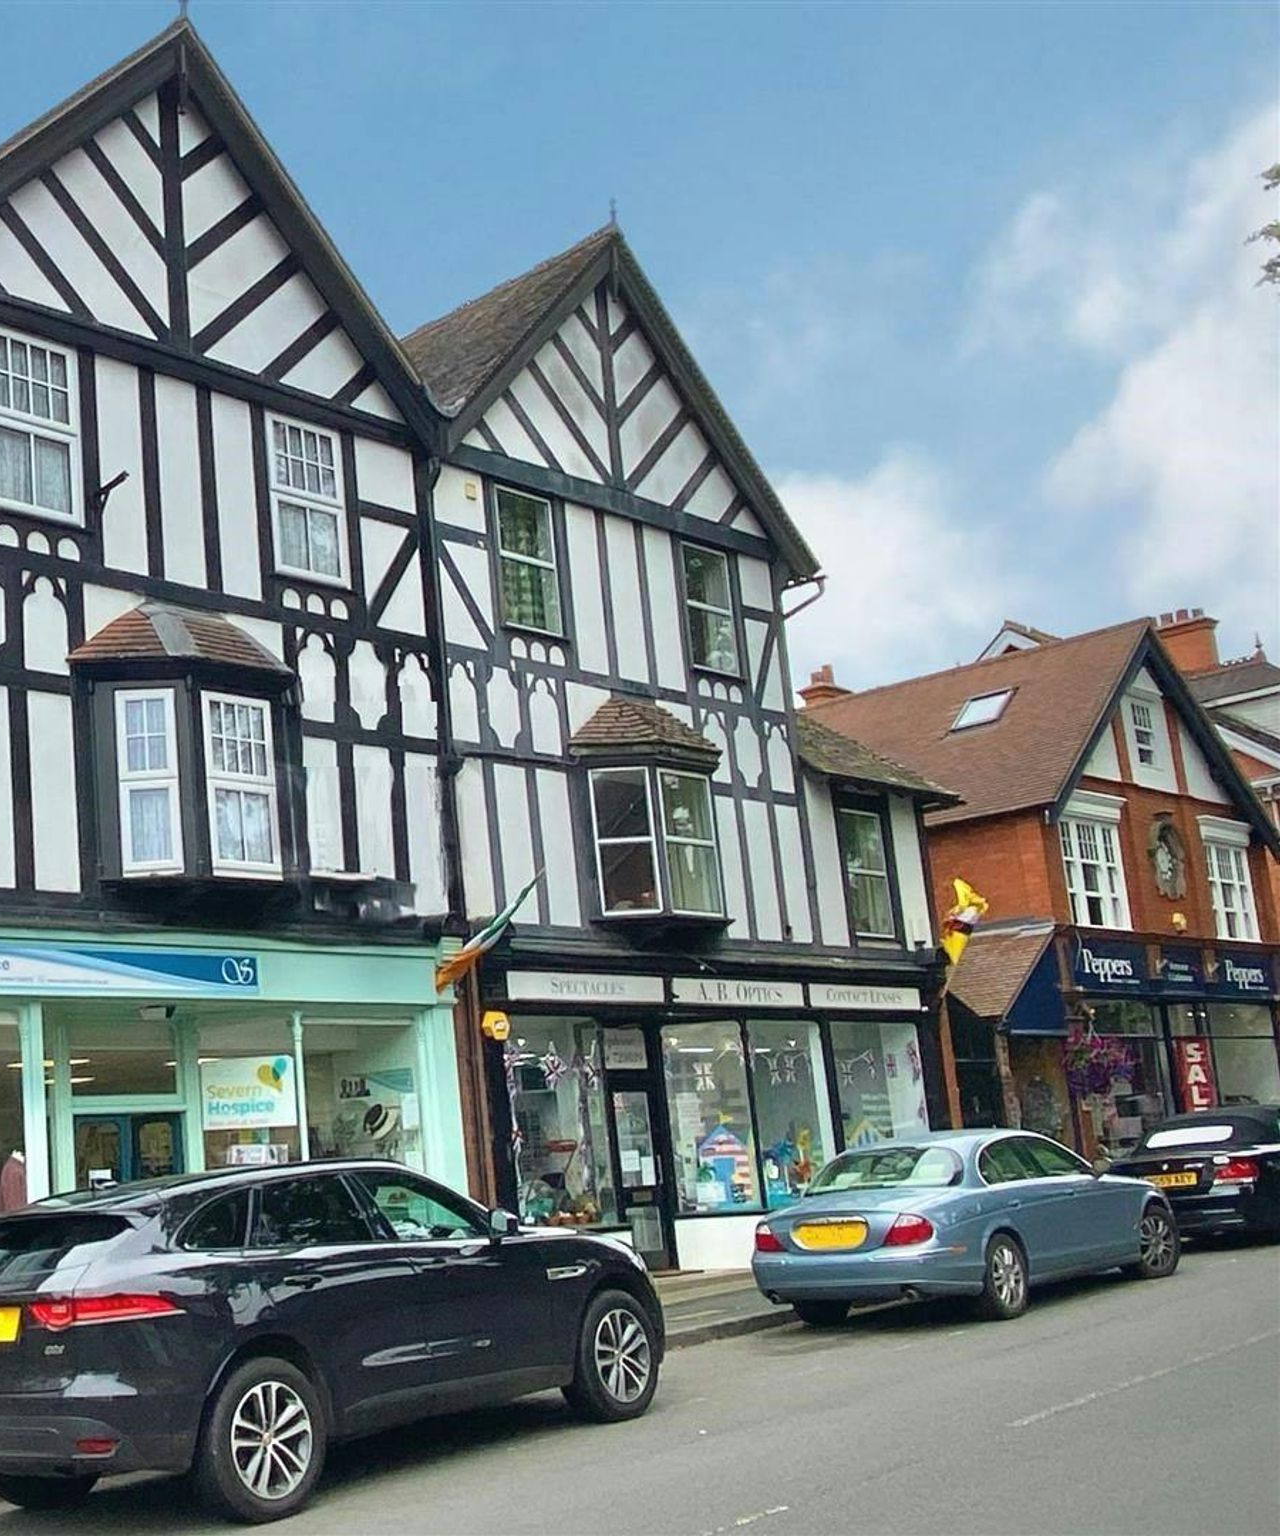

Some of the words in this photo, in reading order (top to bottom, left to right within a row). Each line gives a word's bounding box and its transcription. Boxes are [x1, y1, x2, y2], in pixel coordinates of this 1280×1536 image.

[1083, 948, 1133, 982] Peppers
[1224, 960, 1264, 989] Peppers
[207, 1085, 261, 1099] Severn
[1186, 1043, 1209, 1112] SAL
[207, 1101, 275, 1116] Hospice
